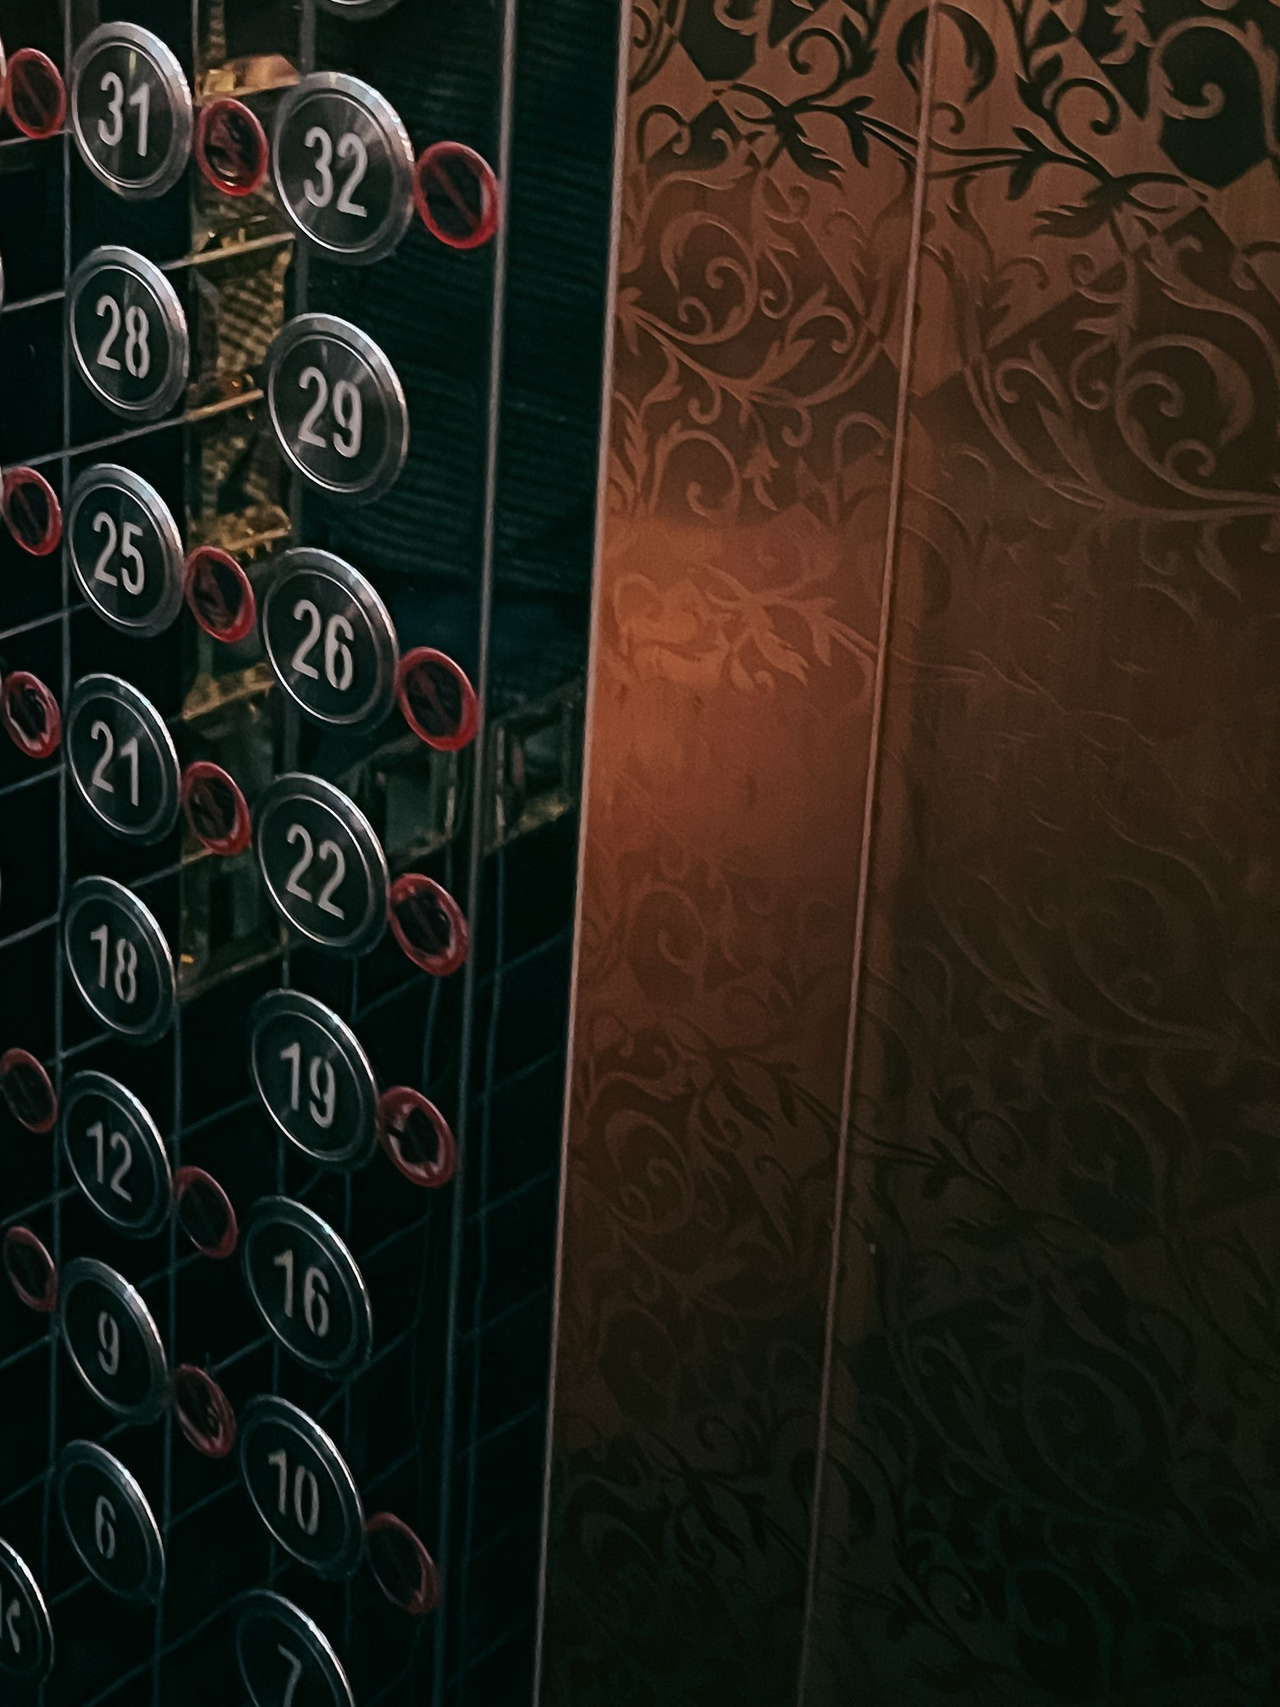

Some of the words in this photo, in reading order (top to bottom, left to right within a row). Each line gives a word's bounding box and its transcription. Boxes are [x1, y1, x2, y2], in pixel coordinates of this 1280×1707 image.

[100, 72, 149, 157] 31
[303, 127, 367, 217] 32
[96, 296, 149, 377] 28
[298, 367, 362, 457] 29
[93, 512, 144, 594] 25
[292, 599, 353, 690] 26
[91, 722, 139, 805] 21
[286, 824, 345, 920] 22
[91, 924, 137, 1004] 18
[280, 1042, 334, 1128] 19
[86, 1124, 132, 1202] 12
[274, 1250, 329, 1336] 16
[97, 1312, 120, 1375] 9
[95, 1495, 117, 1559] 6
[268, 1450, 318, 1536] 10
[278, 1643, 301, 1707] 7
